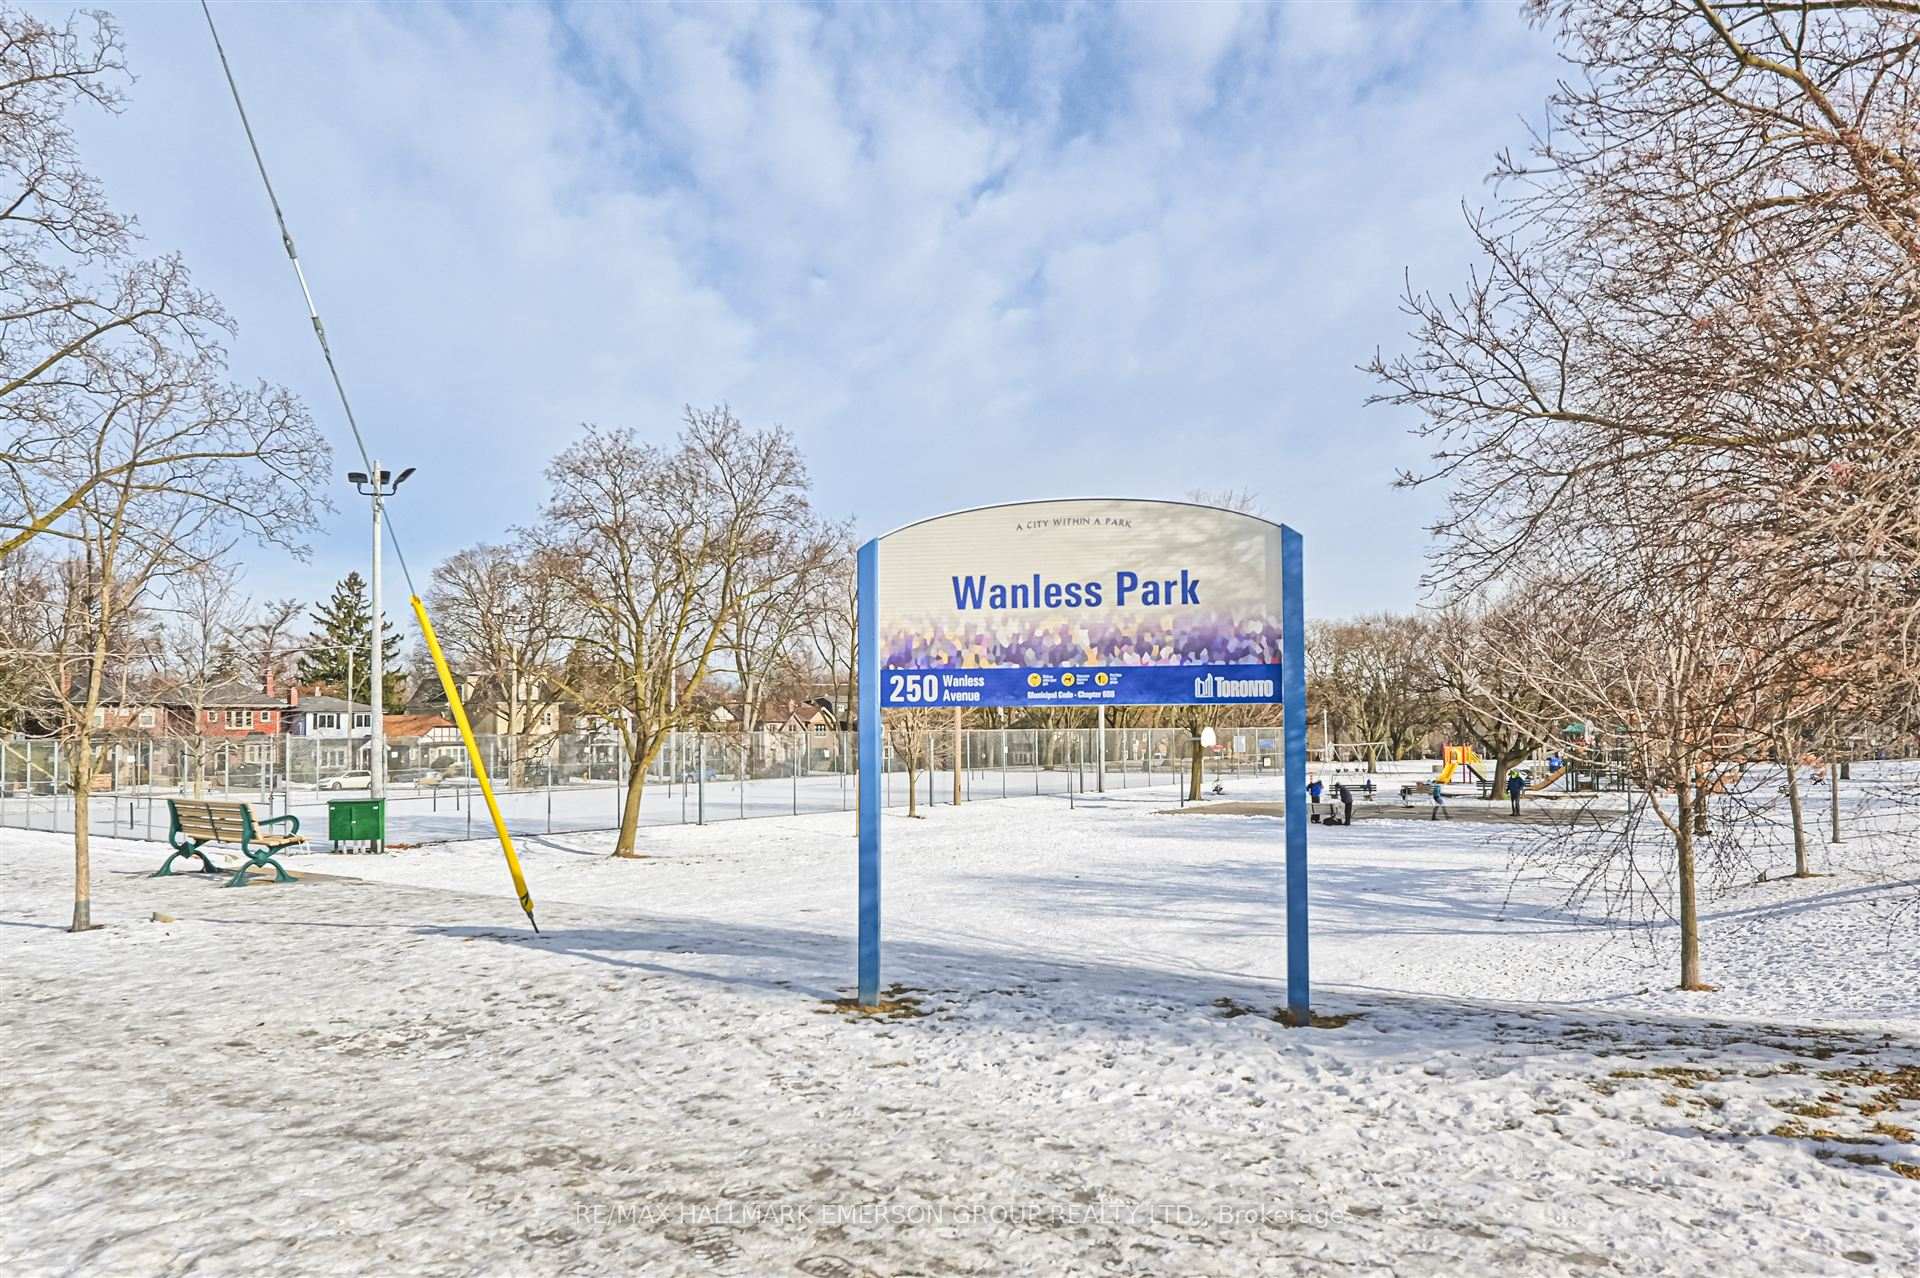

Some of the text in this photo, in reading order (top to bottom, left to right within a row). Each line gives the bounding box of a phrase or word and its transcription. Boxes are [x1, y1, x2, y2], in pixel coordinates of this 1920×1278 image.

[1016, 517, 1132, 531] A CITY WITHIN A PARK
[952, 569, 1200, 610] Wanless Park
[889, 674, 985, 703] 250 Wanless
[942, 689, 981, 702] Avenue
[1214, 677, 1274, 698] TORONTO
